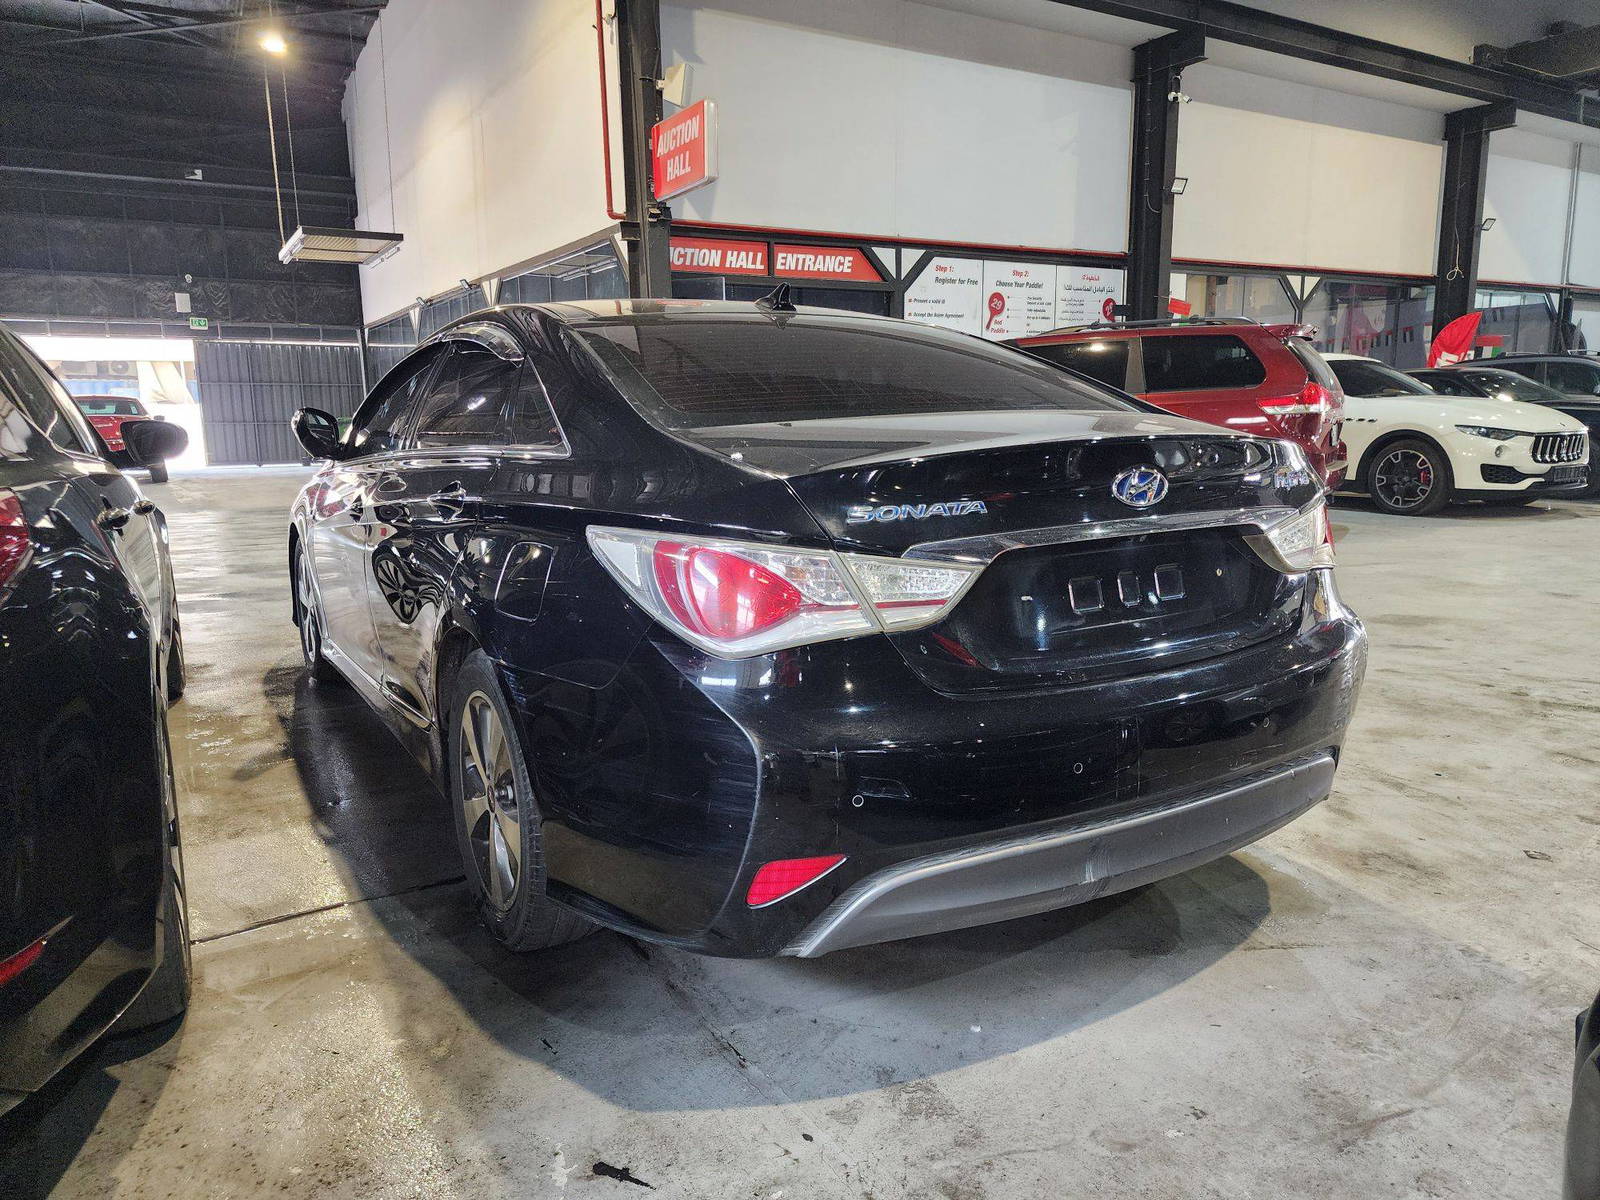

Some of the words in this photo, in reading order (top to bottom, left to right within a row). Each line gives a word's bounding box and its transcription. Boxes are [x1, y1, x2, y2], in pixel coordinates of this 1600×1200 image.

[656, 114, 700, 158] AUCTION
[666, 150, 692, 182] HALL
[669, 246, 720, 267] CTION
[725, 249, 765, 270] HALL
[776, 252, 854, 273] ENTRANCE
[935, 264, 948, 273] Step
[1012, 269, 1023, 278] Step
[935, 276, 957, 286] Register
[958, 277, 966, 285] for
[966, 278, 979, 286] Free
[995, 279, 1013, 288] Choose
[1014, 281, 1025, 289] Your
[990, 297, 1003, 310] 29
[846, 500, 988, 524] SONATA
